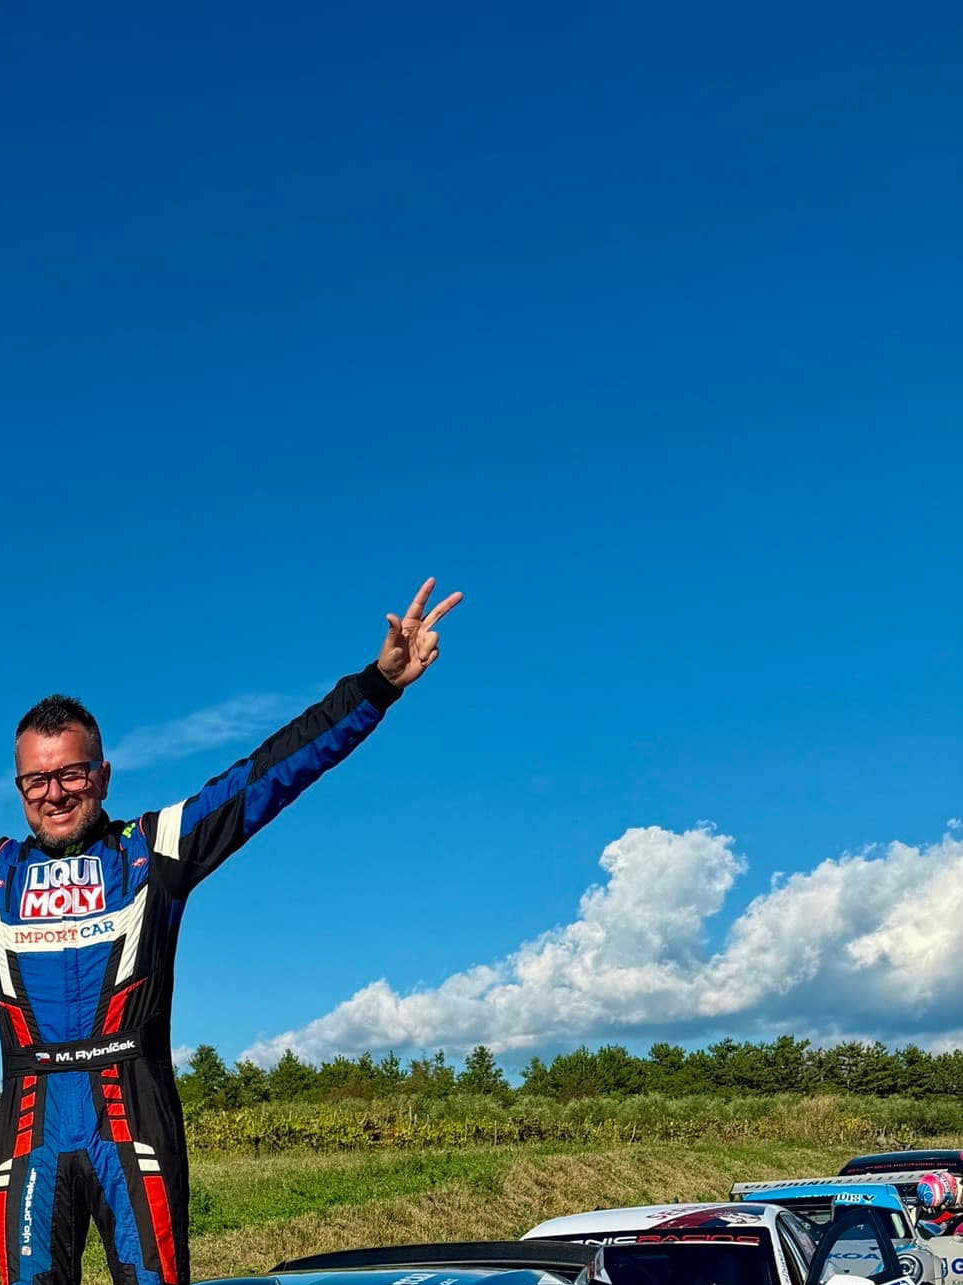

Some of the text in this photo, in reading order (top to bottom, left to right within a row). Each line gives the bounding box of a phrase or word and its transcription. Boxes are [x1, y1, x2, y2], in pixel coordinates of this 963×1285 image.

[30, 859, 98, 890] LIQUI
[24, 886, 101, 917] MOLY
[55, 1040, 136, 1062] M. Rybníček
